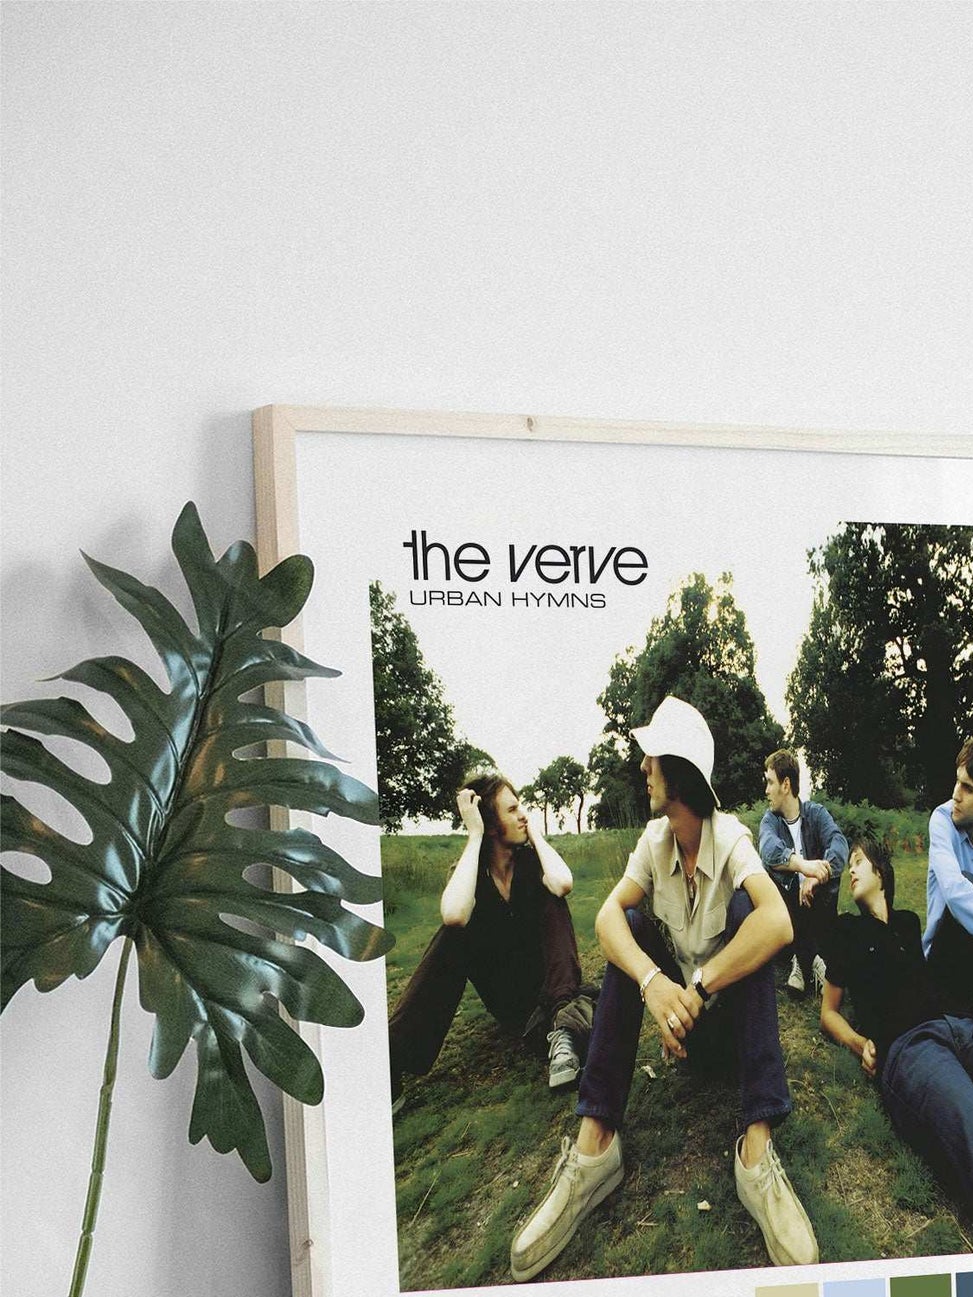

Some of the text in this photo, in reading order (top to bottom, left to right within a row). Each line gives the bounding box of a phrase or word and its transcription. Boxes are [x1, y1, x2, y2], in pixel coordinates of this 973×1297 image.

[402, 529, 648, 586] the verve
[409, 589, 606, 608] URBAN HYMNS
